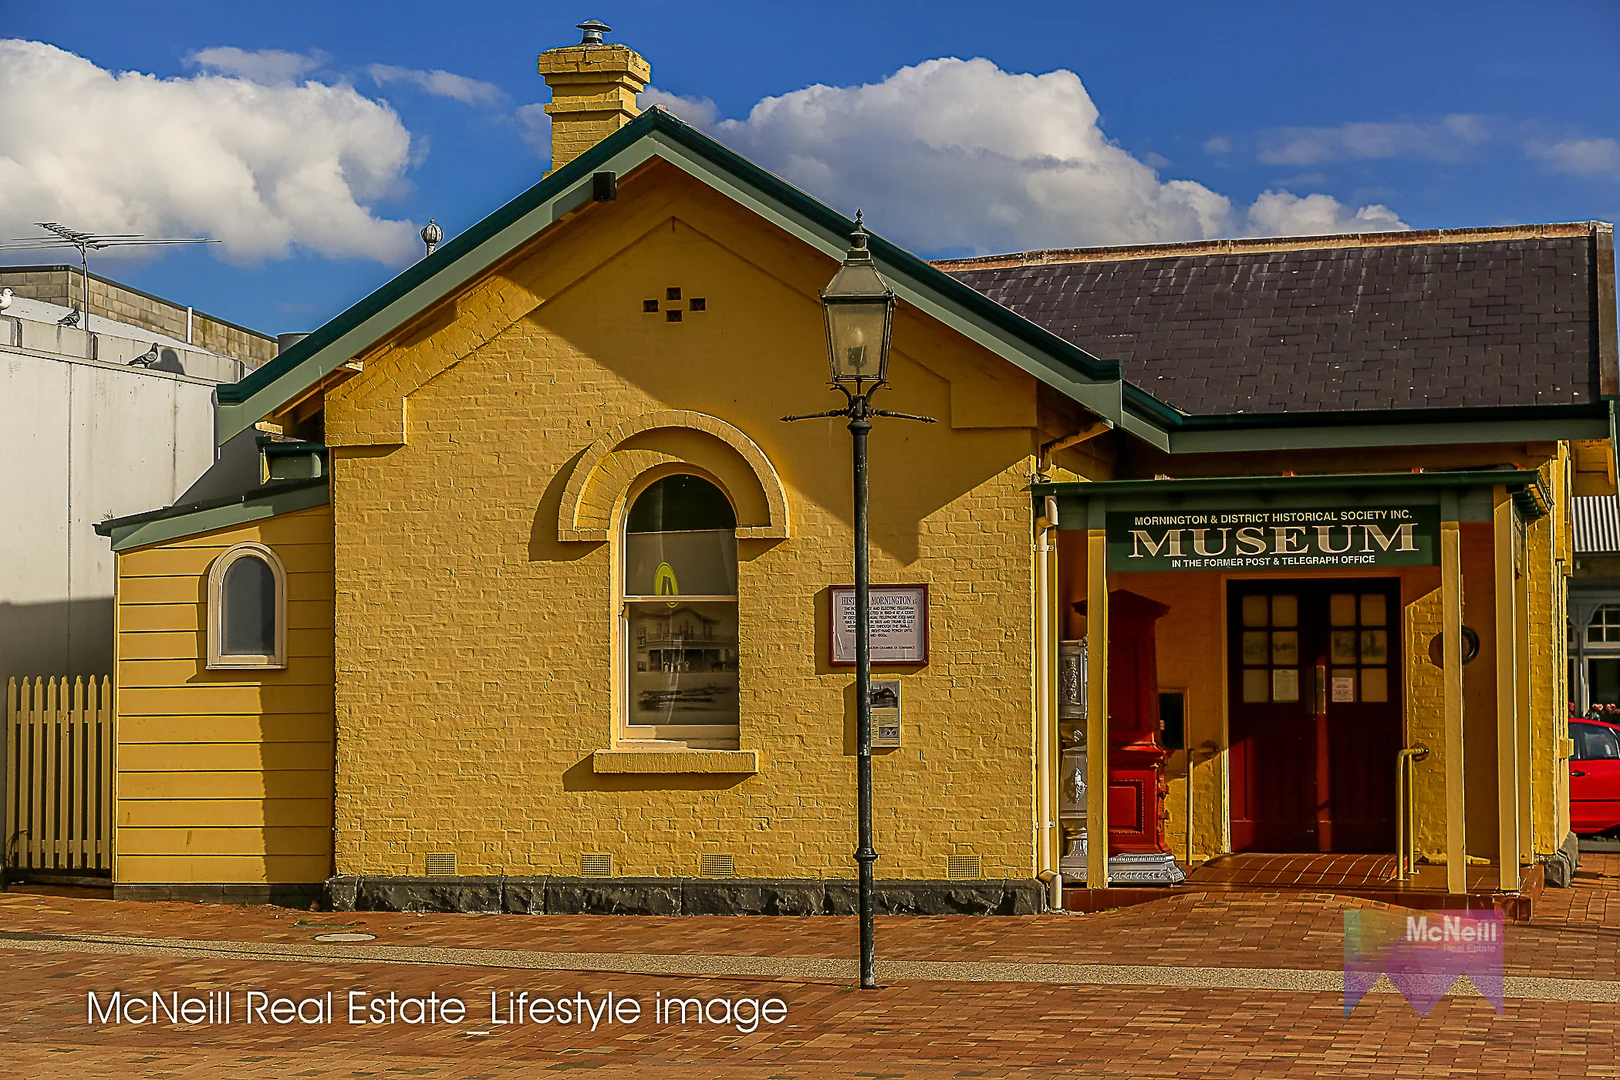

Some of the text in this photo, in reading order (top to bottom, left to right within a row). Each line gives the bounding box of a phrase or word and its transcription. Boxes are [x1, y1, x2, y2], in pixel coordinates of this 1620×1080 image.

[1134, 509, 1413, 526] MORNINGTON & DISTRICT HISTORICAL SOCIETY INC.
[1128, 523, 1419, 557] MUSEUM
[1171, 554, 1376, 568] IN THE FORMER POST & TELEGRAPH OFFICE
